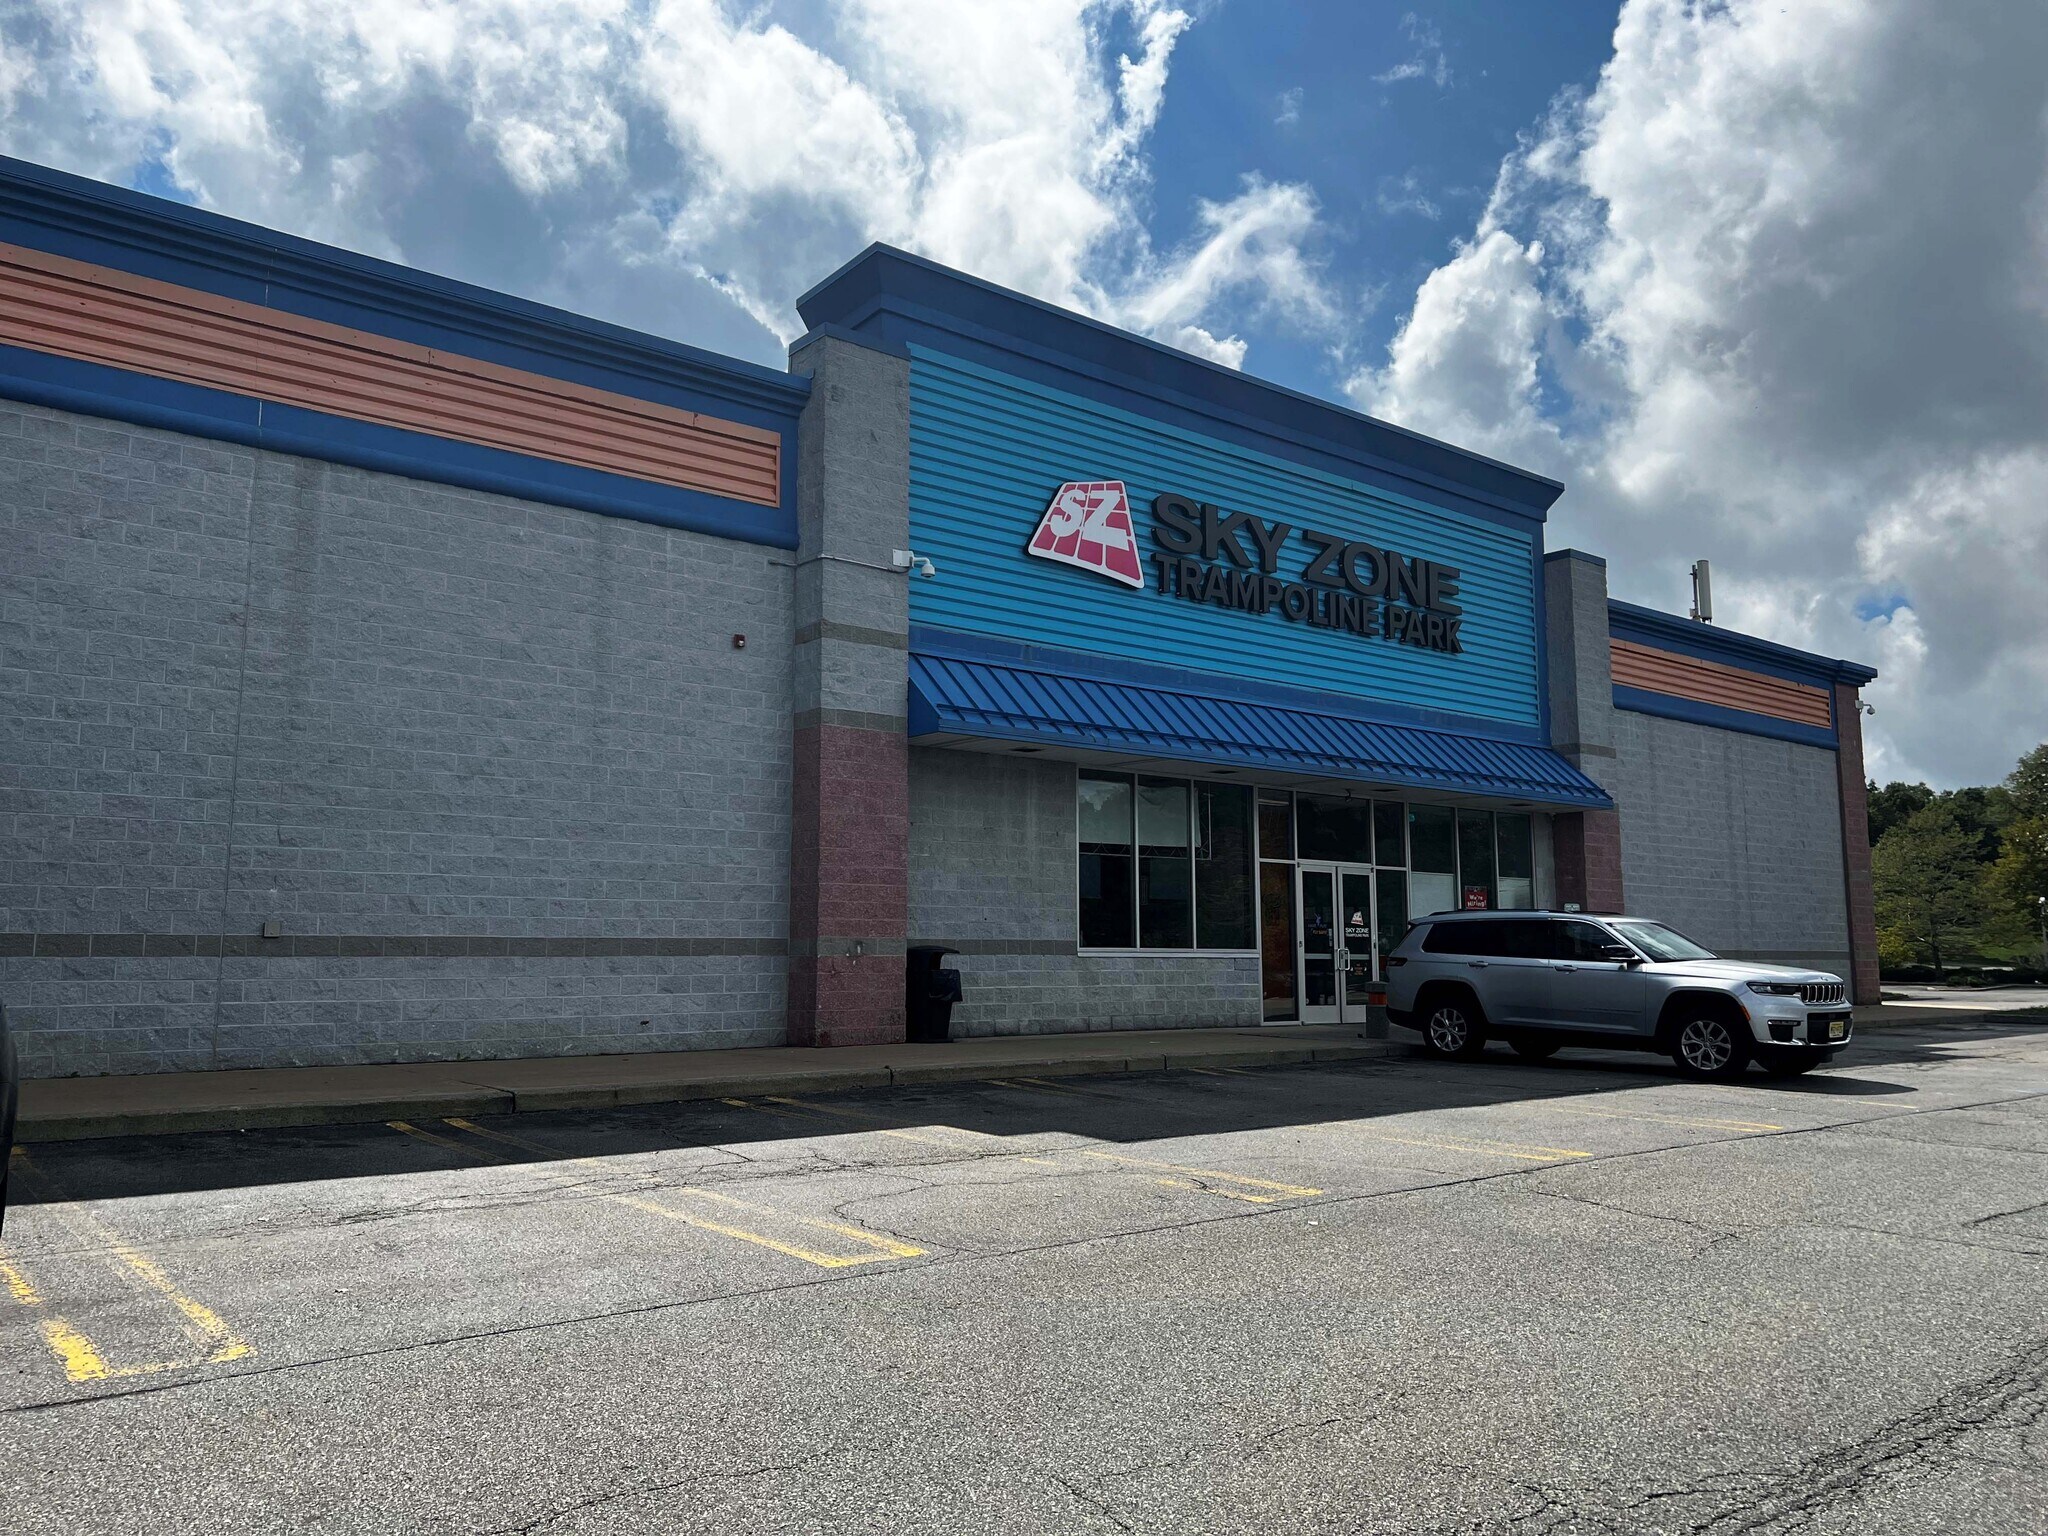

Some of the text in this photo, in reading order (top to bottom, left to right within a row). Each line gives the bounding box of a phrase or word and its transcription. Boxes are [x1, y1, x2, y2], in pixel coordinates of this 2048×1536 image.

[1050, 489, 1130, 549] SZ
[1151, 493, 1463, 616] SKY ZONE
[1151, 552, 1465, 654] TRAMPOLINE PARK
